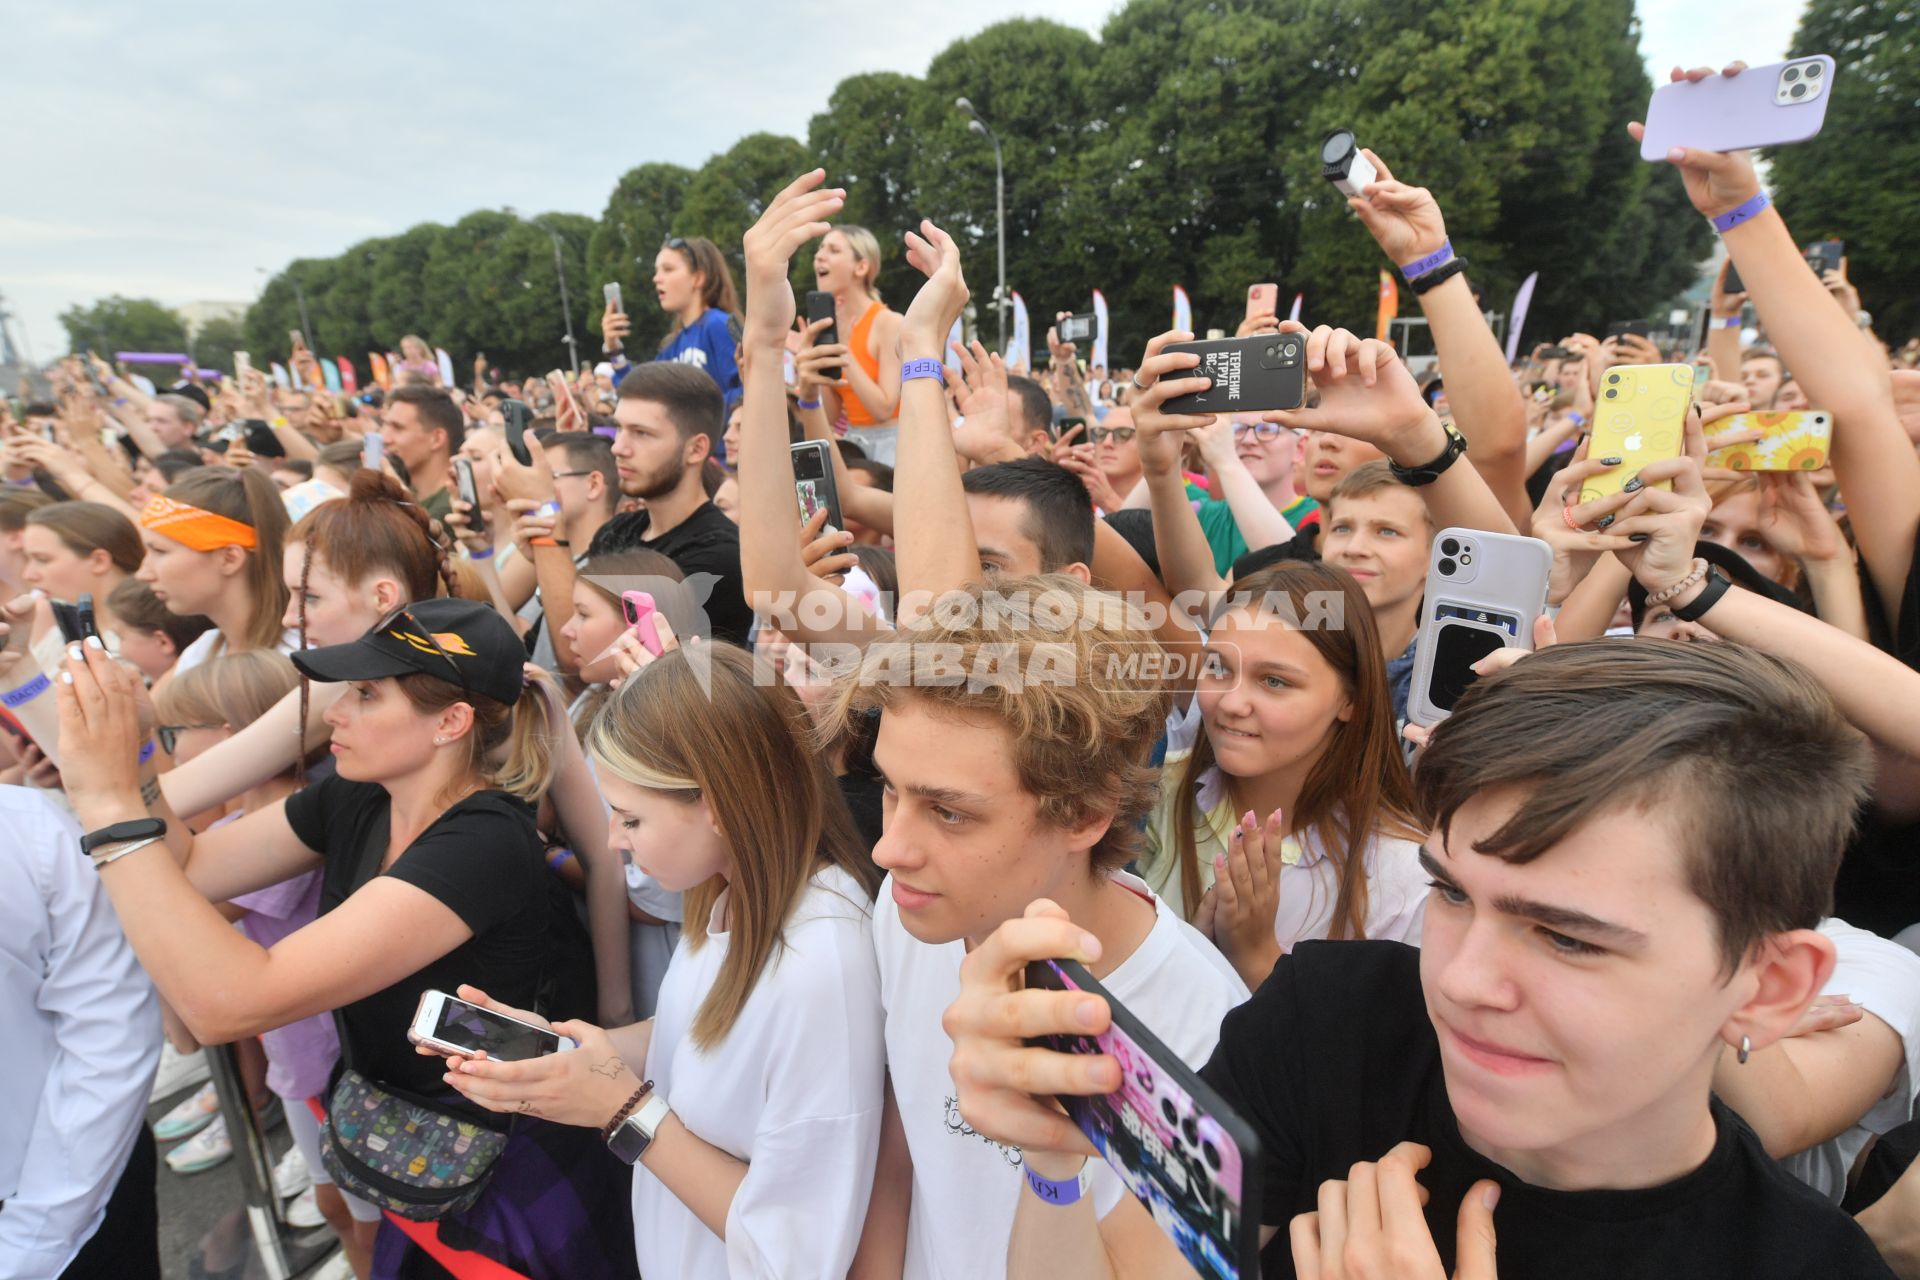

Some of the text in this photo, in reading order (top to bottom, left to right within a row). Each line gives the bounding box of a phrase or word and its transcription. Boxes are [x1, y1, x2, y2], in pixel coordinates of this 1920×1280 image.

[1215, 351, 1229, 388] И ТРУД
[1228, 350, 1241, 400] ТЕРПЕНИЕ
